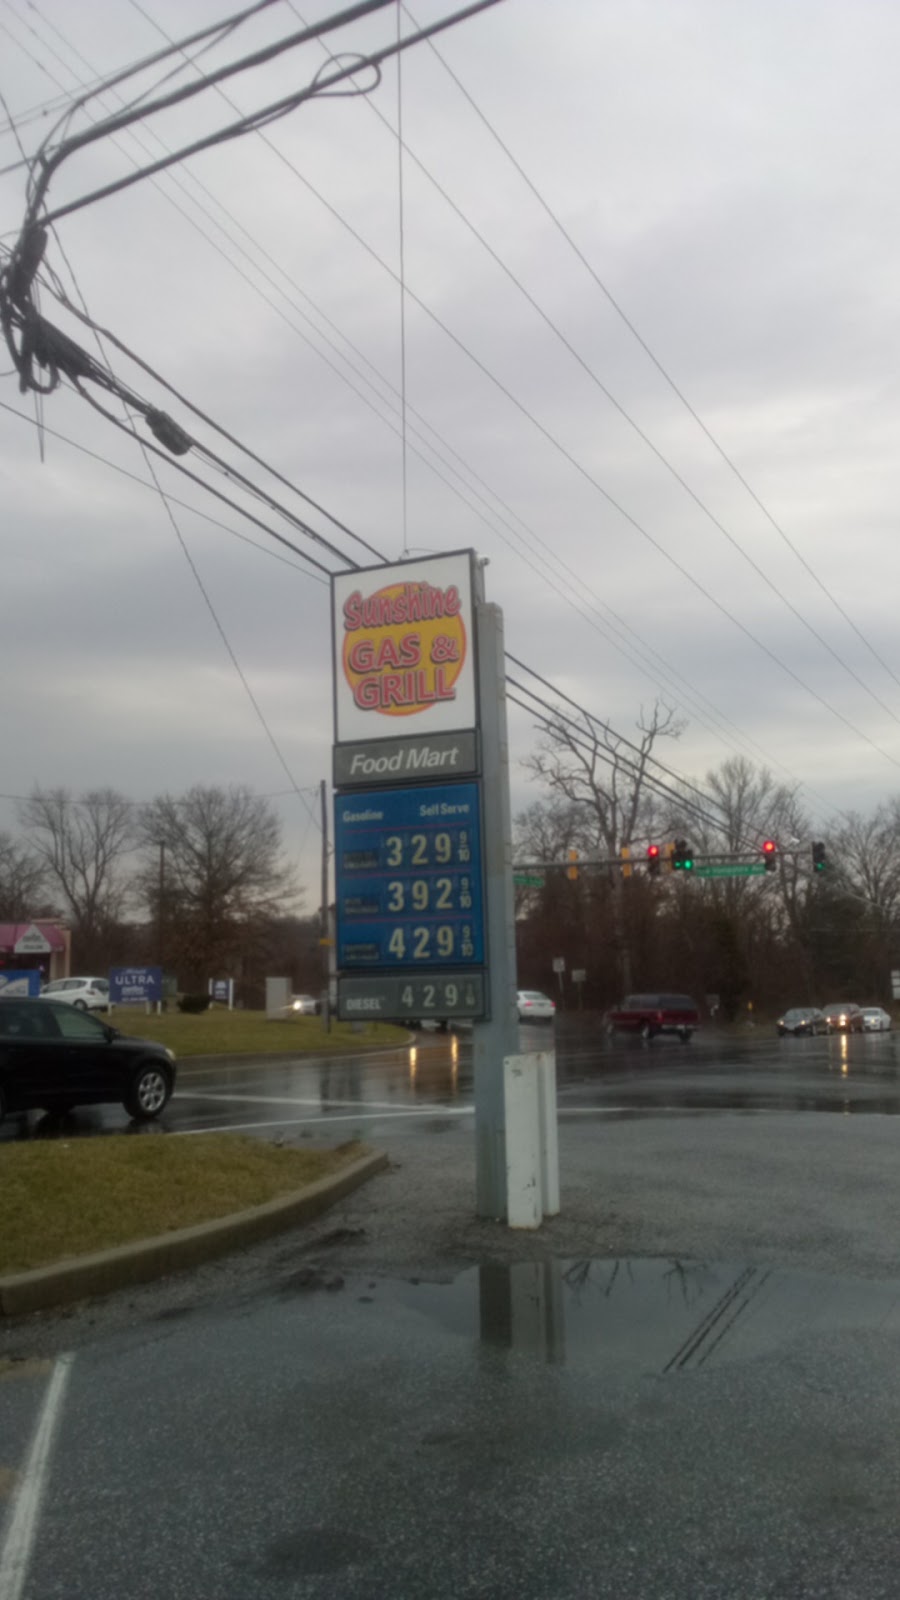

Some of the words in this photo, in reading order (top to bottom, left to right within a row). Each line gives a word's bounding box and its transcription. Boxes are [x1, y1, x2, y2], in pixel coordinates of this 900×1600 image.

[343, 581, 461, 631] Sunshine
[349, 633, 420, 673] GAS
[430, 633, 458, 664] &
[354, 667, 456, 710] GRILL
[350, 750, 404, 774] Food
[405, 747, 458, 769] Mart
[343, 809, 384, 823] Gasoline
[440, 802, 469, 815] Serve
[386, 832, 452, 866] 329
[387, 878, 453, 912] 392
[388, 925, 455, 959] 429
[114, 975, 155, 985] ULTRA
[346, 998, 381, 1010] DIESEL
